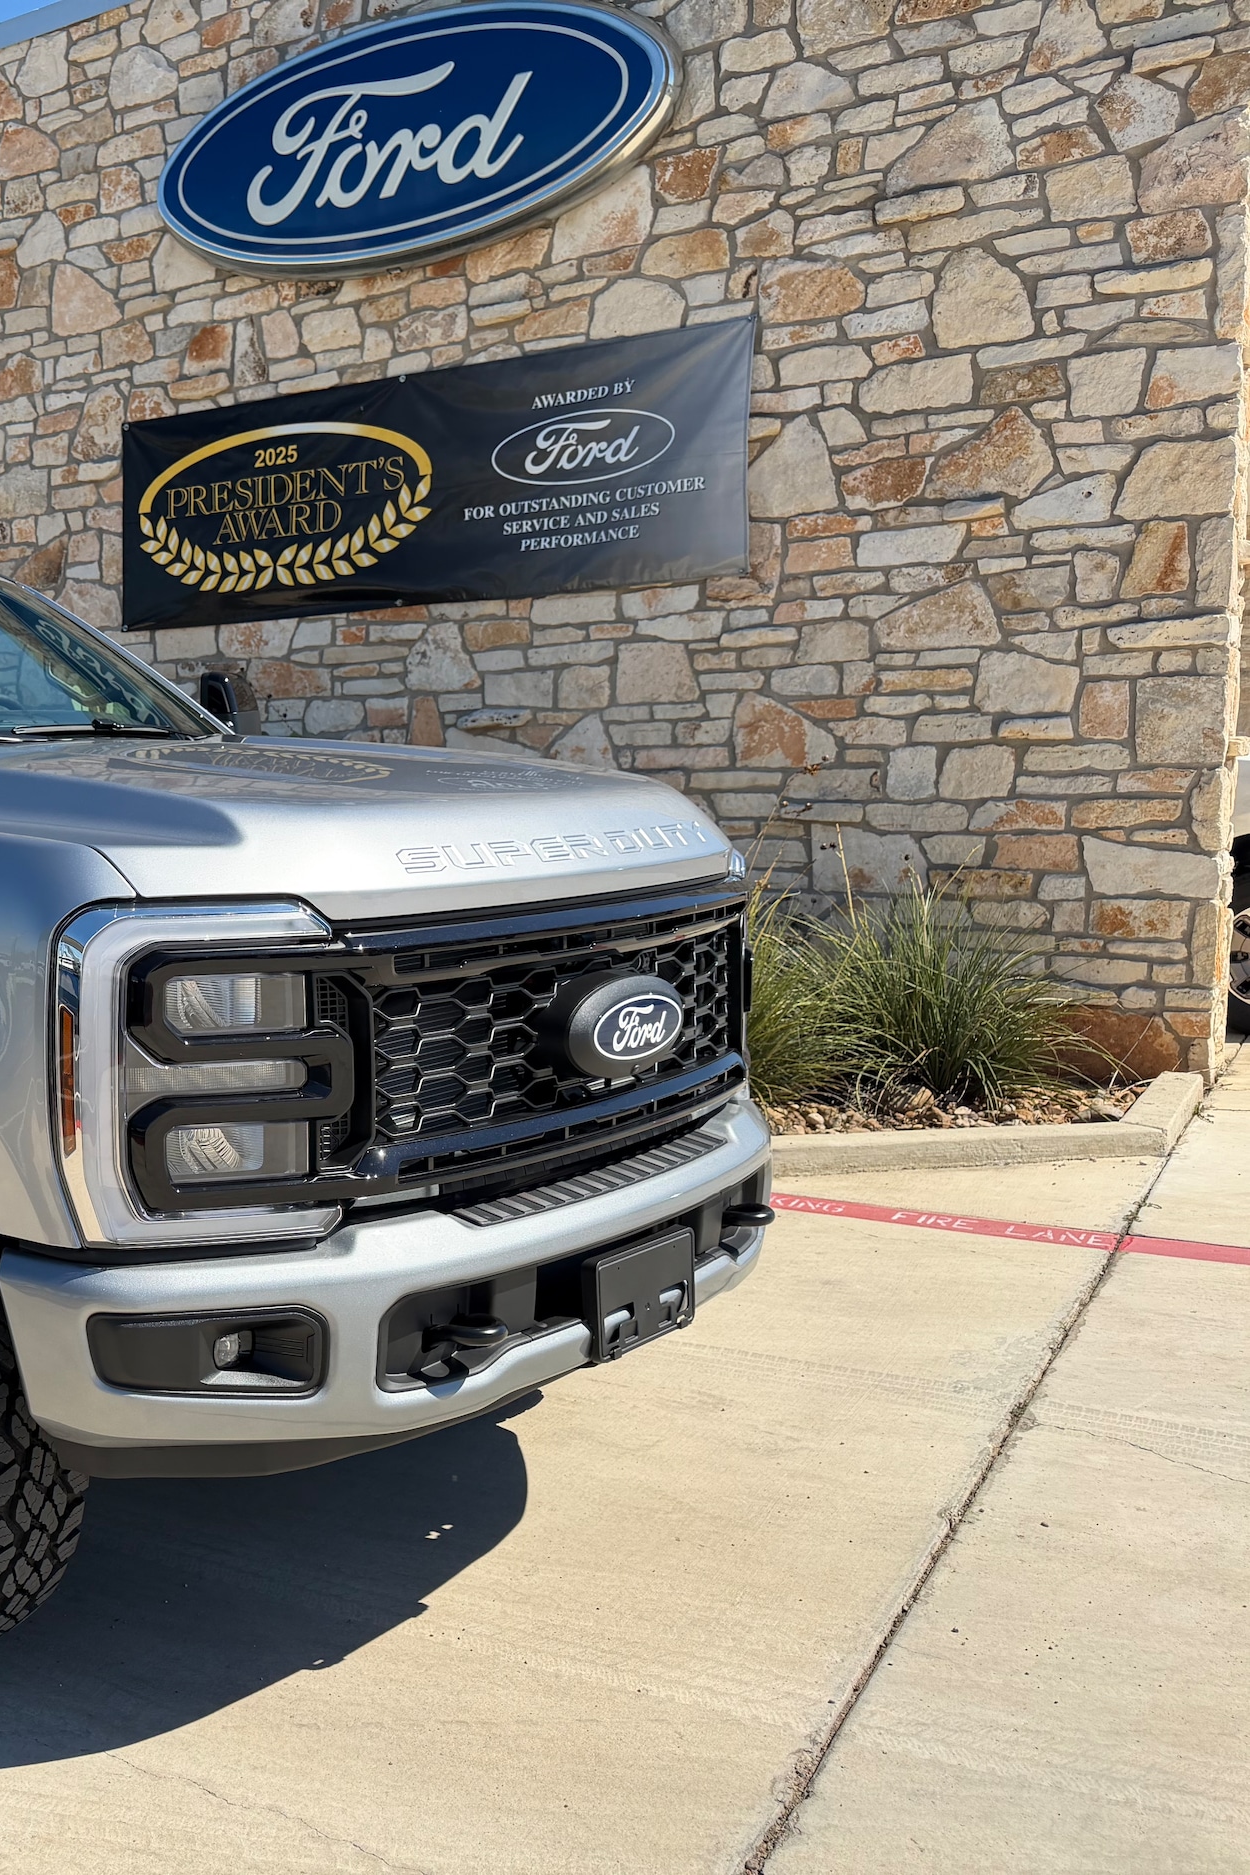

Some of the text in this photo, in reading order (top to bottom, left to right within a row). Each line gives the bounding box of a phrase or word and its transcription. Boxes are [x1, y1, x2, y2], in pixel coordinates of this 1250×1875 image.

[247, 61, 533, 226] Ford
[531, 379, 636, 410] AWARDED BY
[254, 444, 298, 468] 2025
[524, 419, 640, 475] Ford
[166, 456, 405, 519] PRESIDENT'S
[463, 477, 706, 521] FOR OUTSTANDING CUSTOMER
[212, 500, 342, 545] AWARD
[502, 502, 660, 536] SERVICE AND SALES
[519, 525, 640, 552] PERFORMANCE
[396, 820, 707, 874] SUPER DUTY
[612, 1003, 668, 1052] Ford
[891, 1211, 979, 1231] FIRE
[1004, 1225, 1114, 1248] LANE
